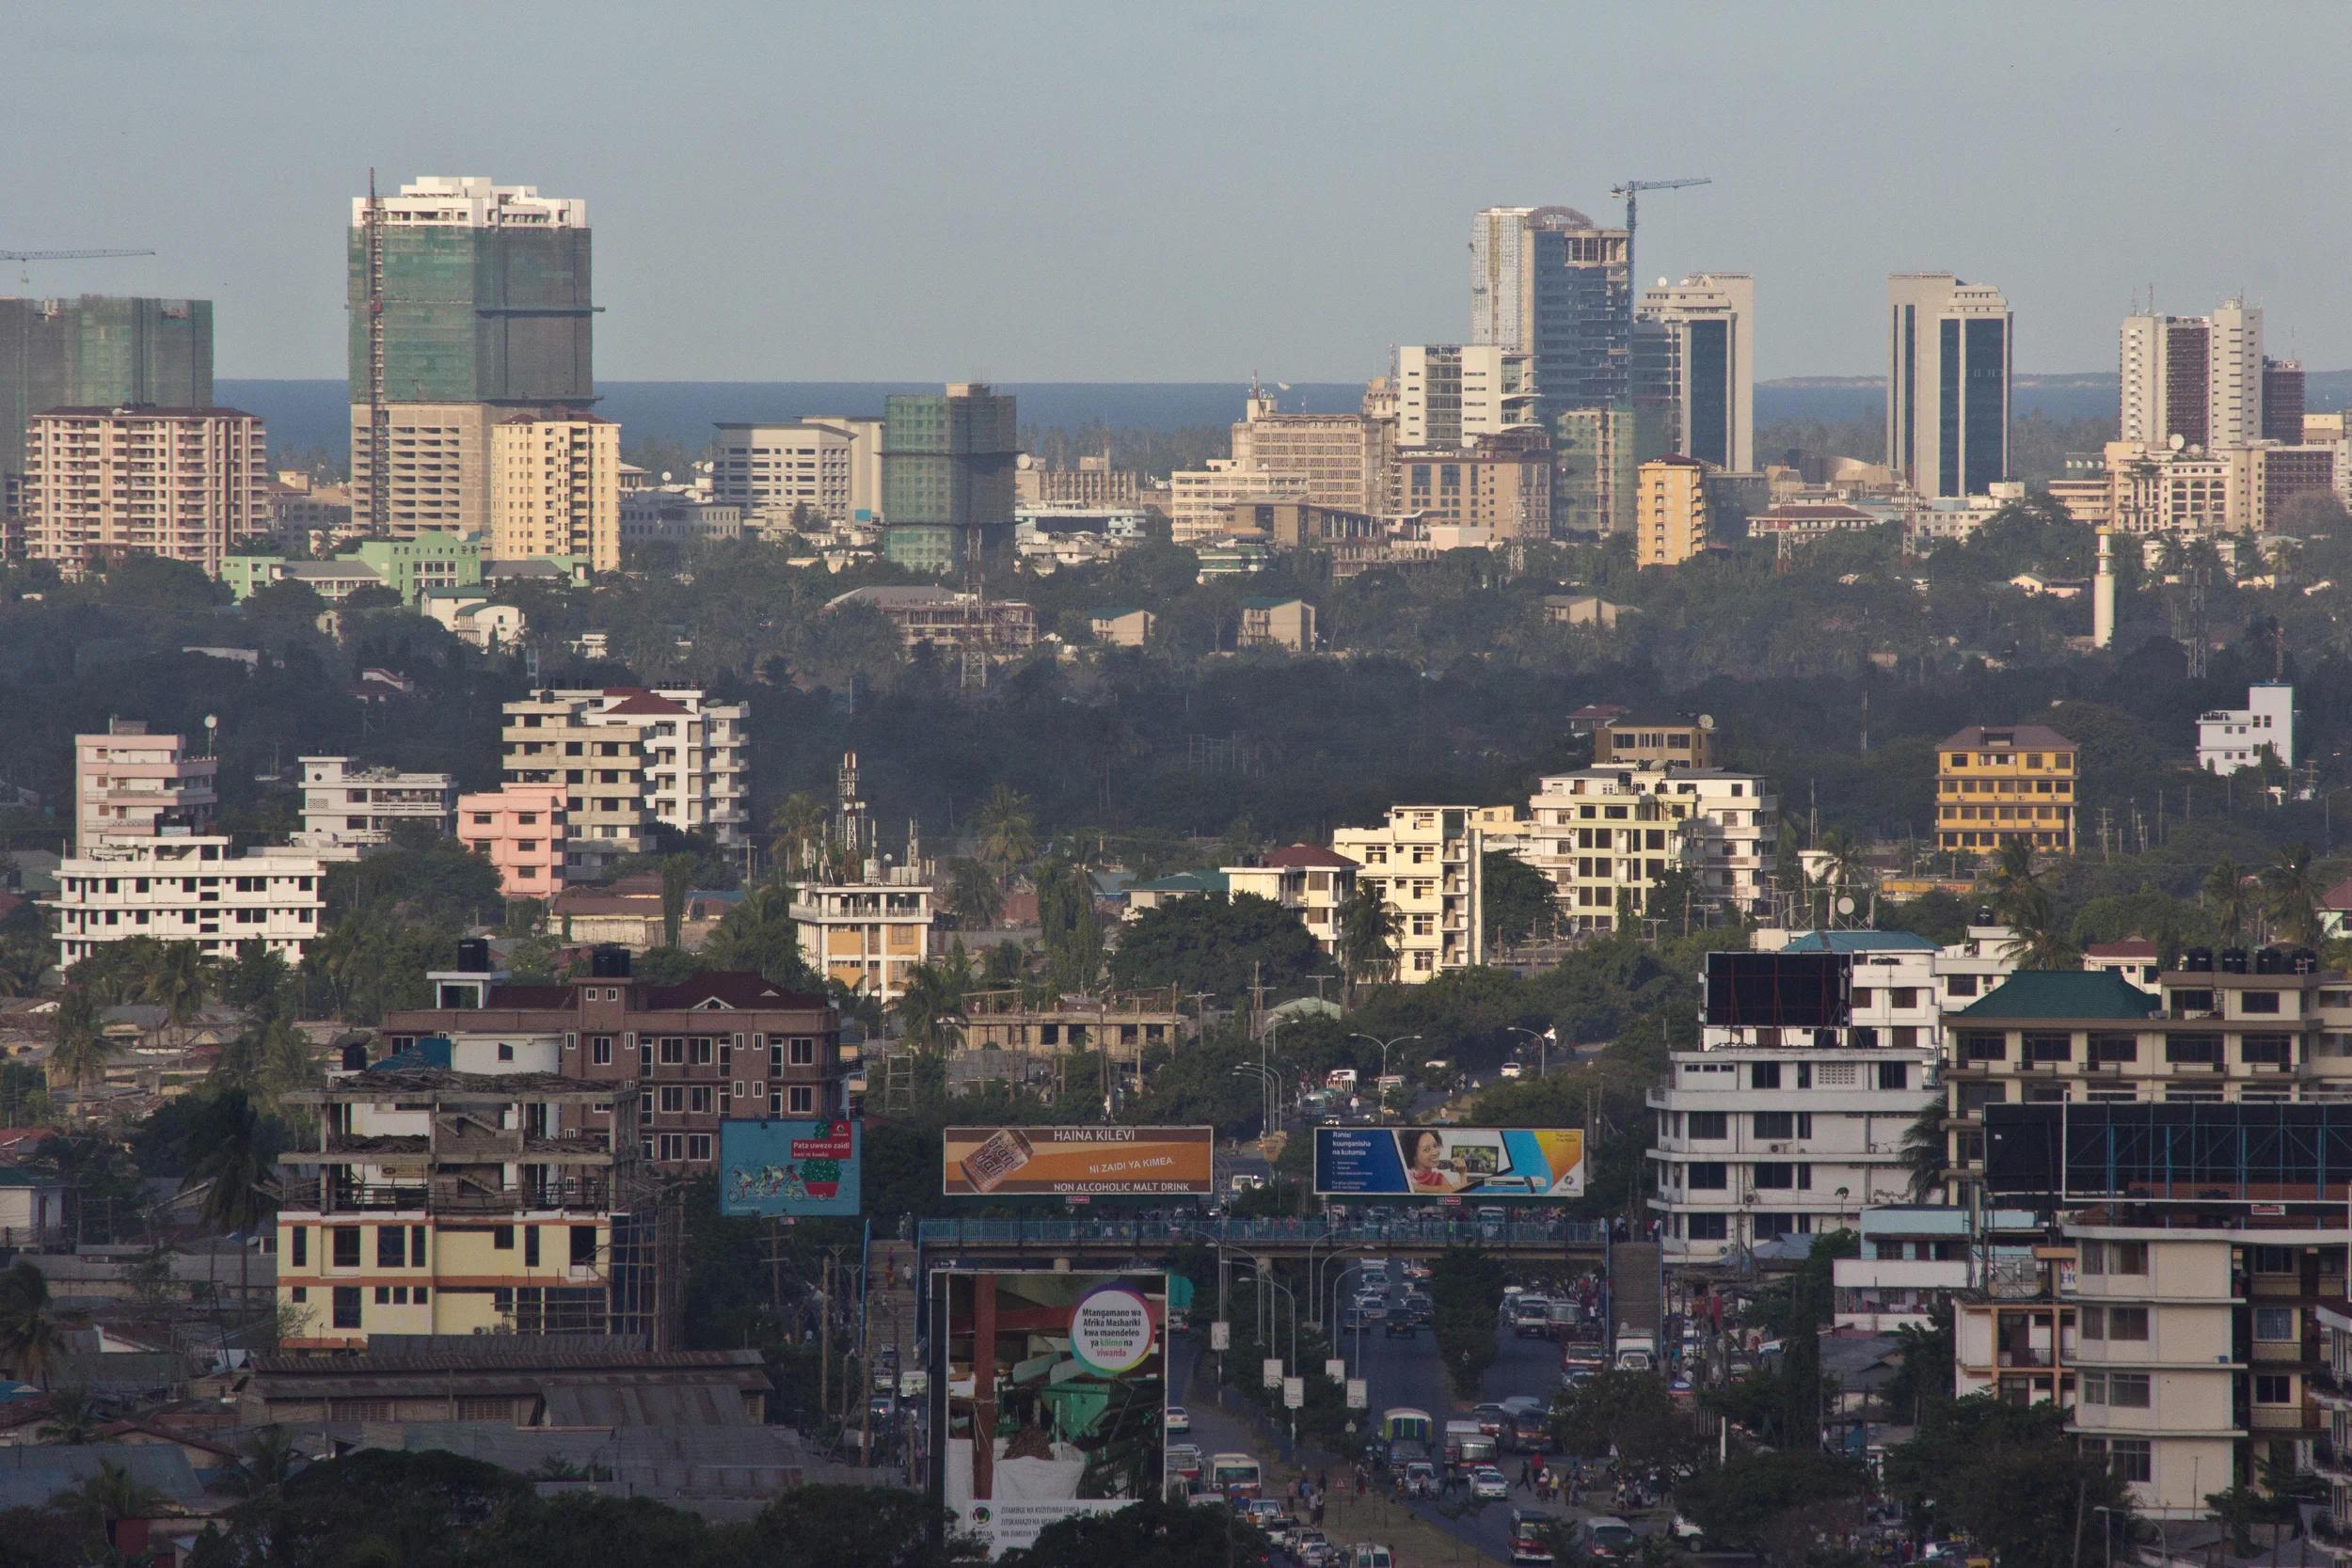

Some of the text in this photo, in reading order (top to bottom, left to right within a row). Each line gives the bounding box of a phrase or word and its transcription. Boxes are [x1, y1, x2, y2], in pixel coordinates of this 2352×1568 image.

[1054, 1130, 1135, 1142] HAINA KILEVI
[987, 1135, 1025, 1171] Grand
[974, 1148, 1005, 1178] Malt
[1089, 1165, 1100, 1175] NI
[1101, 1162, 1126, 1174] ZAIDI
[1128, 1160, 1141, 1170] YA
[1054, 1182, 1189, 1192] NON ALCOHOLIC MALT DRINK
[1082, 1308, 1130, 1319] Mtangamano
[1083, 1318, 1140, 1327] Afrika Mashariki
[1084, 1328, 1140, 1337] kwa maendeleo
[1090, 1340, 1099, 1349] ya
[1100, 1338, 1122, 1347] kilimo
[1096, 1348, 1126, 1357] viwanda
